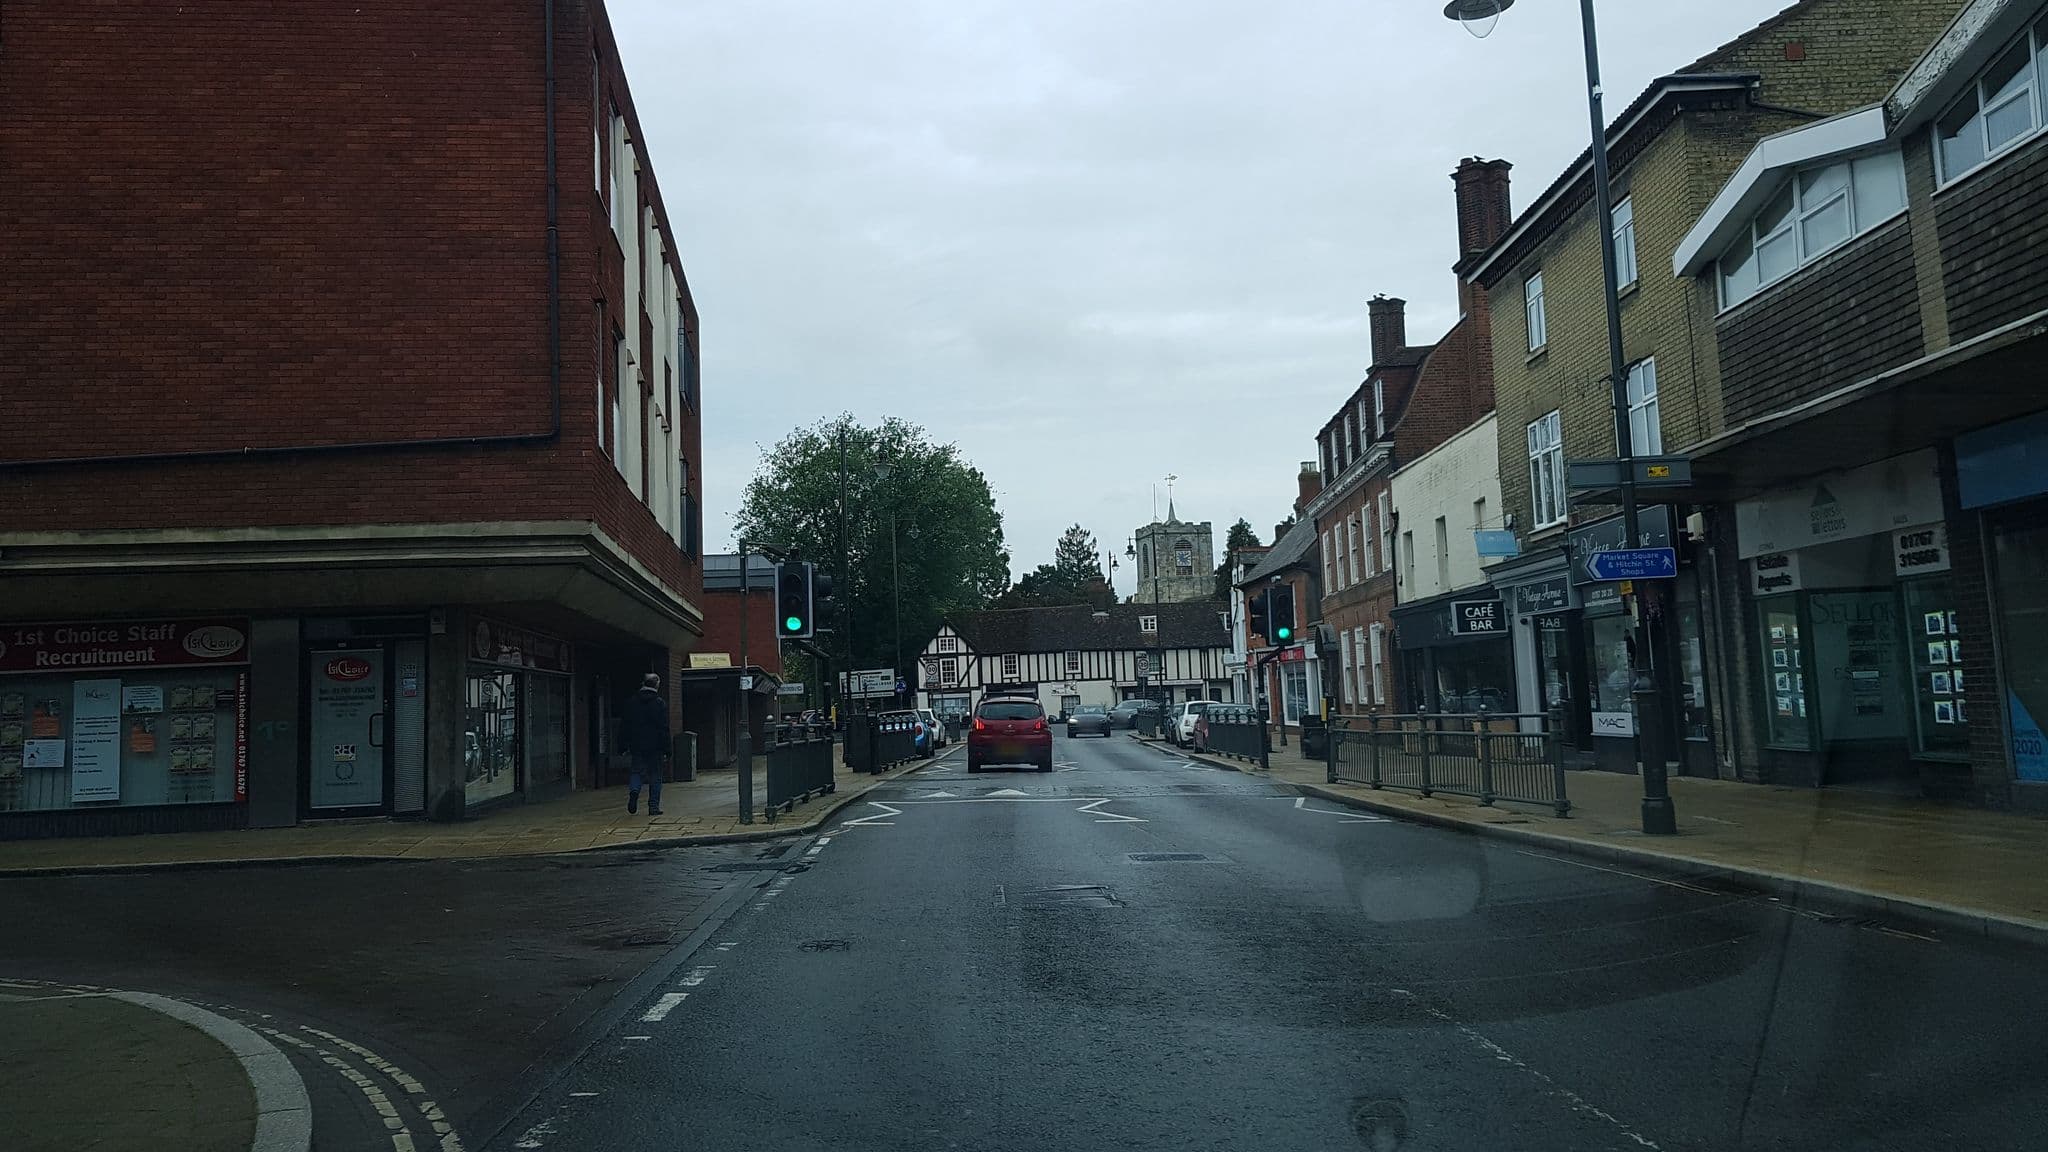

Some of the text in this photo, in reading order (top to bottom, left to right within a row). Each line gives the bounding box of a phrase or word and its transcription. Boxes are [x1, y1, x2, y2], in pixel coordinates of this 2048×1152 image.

[1603, 552, 1659, 561] Market Square
[1757, 555, 1788, 571] Estate
[1758, 571, 1792, 590] Agents
[1465, 603, 1495, 618] CAFÉ
[1470, 619, 1494, 631] BAR
[14, 623, 176, 646] 1st Choice Staff
[35, 646, 156, 667] Recruitment
[1598, 718, 1626, 729] MAC
